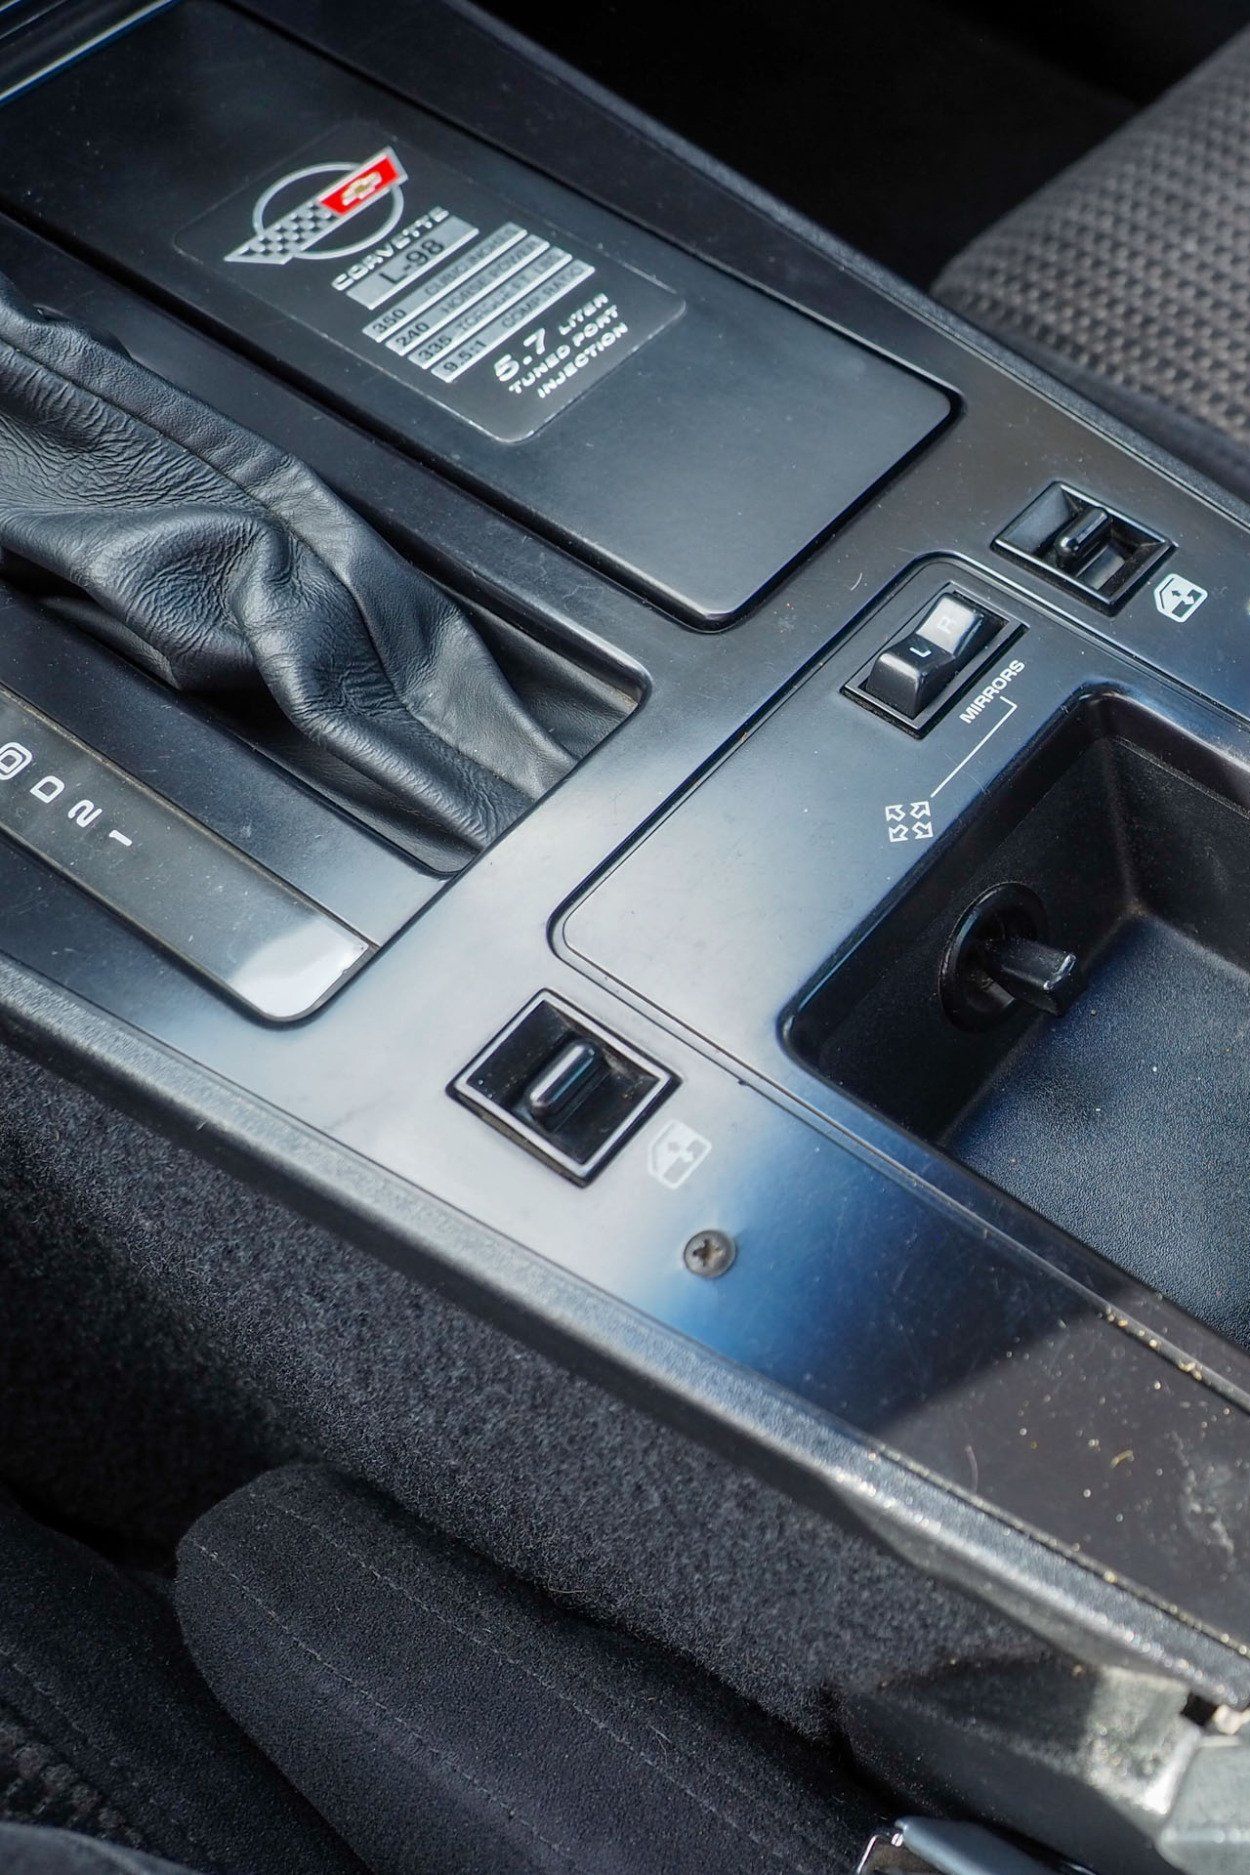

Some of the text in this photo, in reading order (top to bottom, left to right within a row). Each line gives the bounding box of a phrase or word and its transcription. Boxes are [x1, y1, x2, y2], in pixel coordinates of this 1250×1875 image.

[332, 205, 450, 291] CORVETTE
[379, 239, 445, 285] L-98
[372, 308, 407, 335] 350
[395, 322, 431, 348] 240
[494, 292, 609, 382] 5.7 LITER
[418, 336, 453, 361] 335
[443, 339, 488, 373] 9.5:1
[508, 304, 619, 394] TUNED PORT
[537, 322, 629, 399] INJECTION
[909, 646, 932, 658] L
[959, 658, 1026, 725] MIRRORS
[29, 775, 65, 804] D
[68, 799, 103, 828] 2
[108, 829, 133, 847] 1
